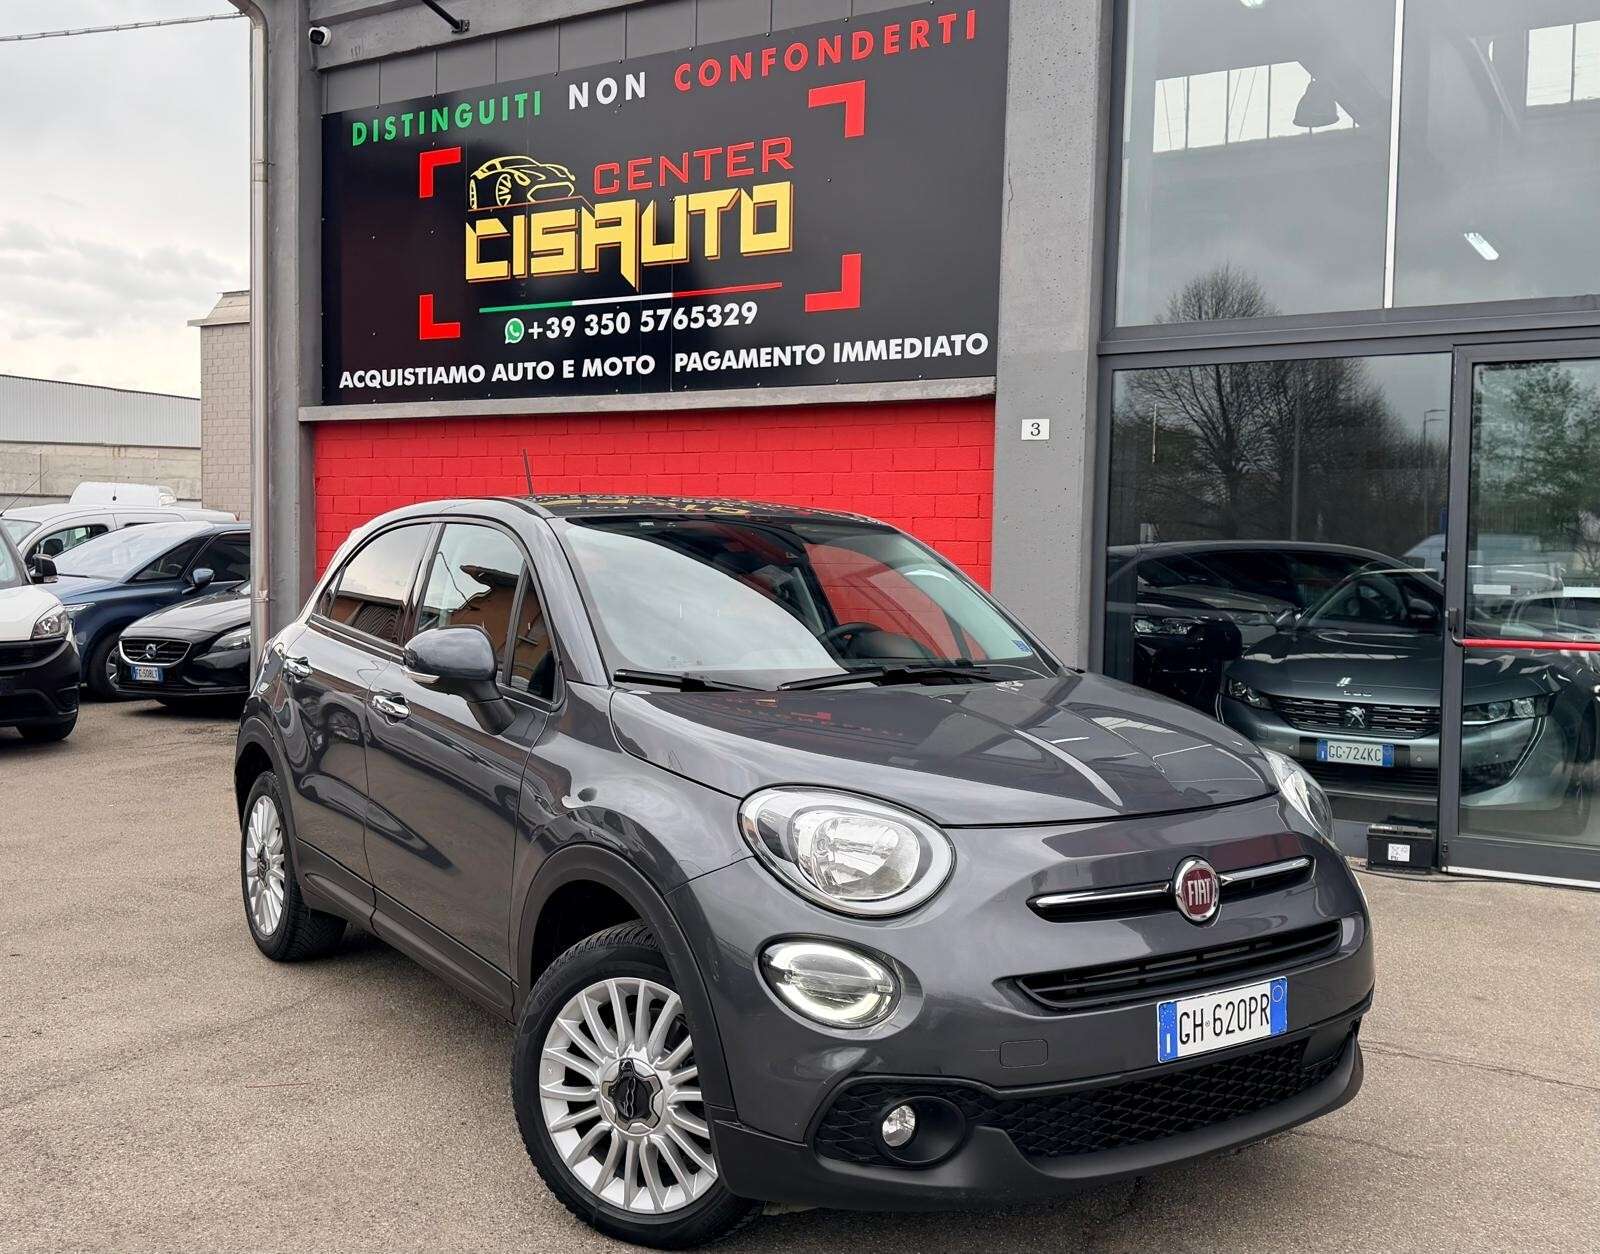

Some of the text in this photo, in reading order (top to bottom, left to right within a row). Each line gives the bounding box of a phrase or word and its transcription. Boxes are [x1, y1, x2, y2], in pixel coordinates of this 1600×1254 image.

[352, 9, 976, 147] DISTINGUITI NON CONFONDERTI
[593, 136, 794, 195] CENTER
[465, 181, 793, 292] CISAUTO
[528, 301, 758, 340] +39 350 5765329
[339, 332, 989, 389] ACQUISTIAMO AUTO E MOTO PAGAMENTO IMMEDIATO
[1030, 422, 1041, 437] 3
[1187, 877, 1212, 906] FIAT
